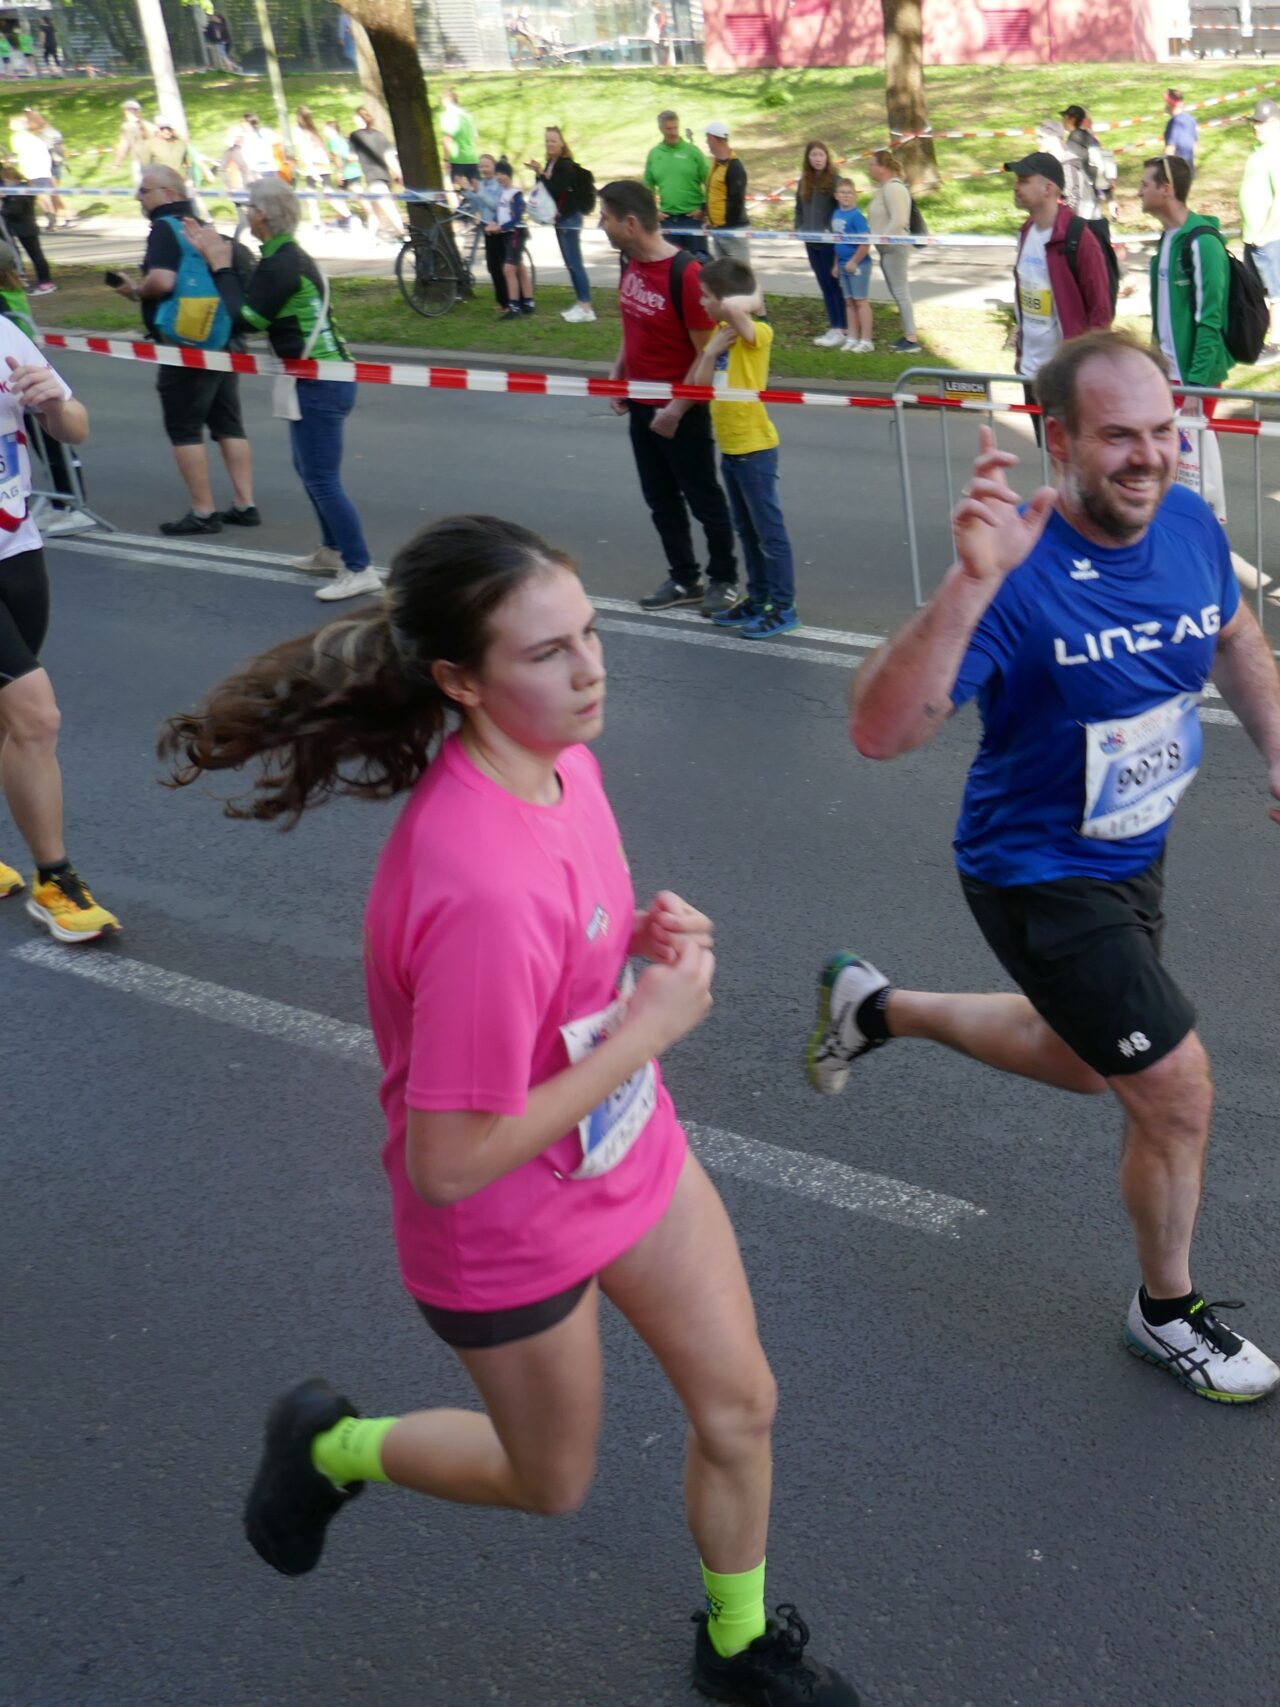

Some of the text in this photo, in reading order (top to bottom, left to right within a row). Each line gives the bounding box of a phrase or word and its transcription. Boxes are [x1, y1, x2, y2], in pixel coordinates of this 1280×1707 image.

[945, 381, 986, 393] LEIRICH
[1054, 603, 1222, 667] LINZ AG
[1117, 740, 1181, 795] 9078
